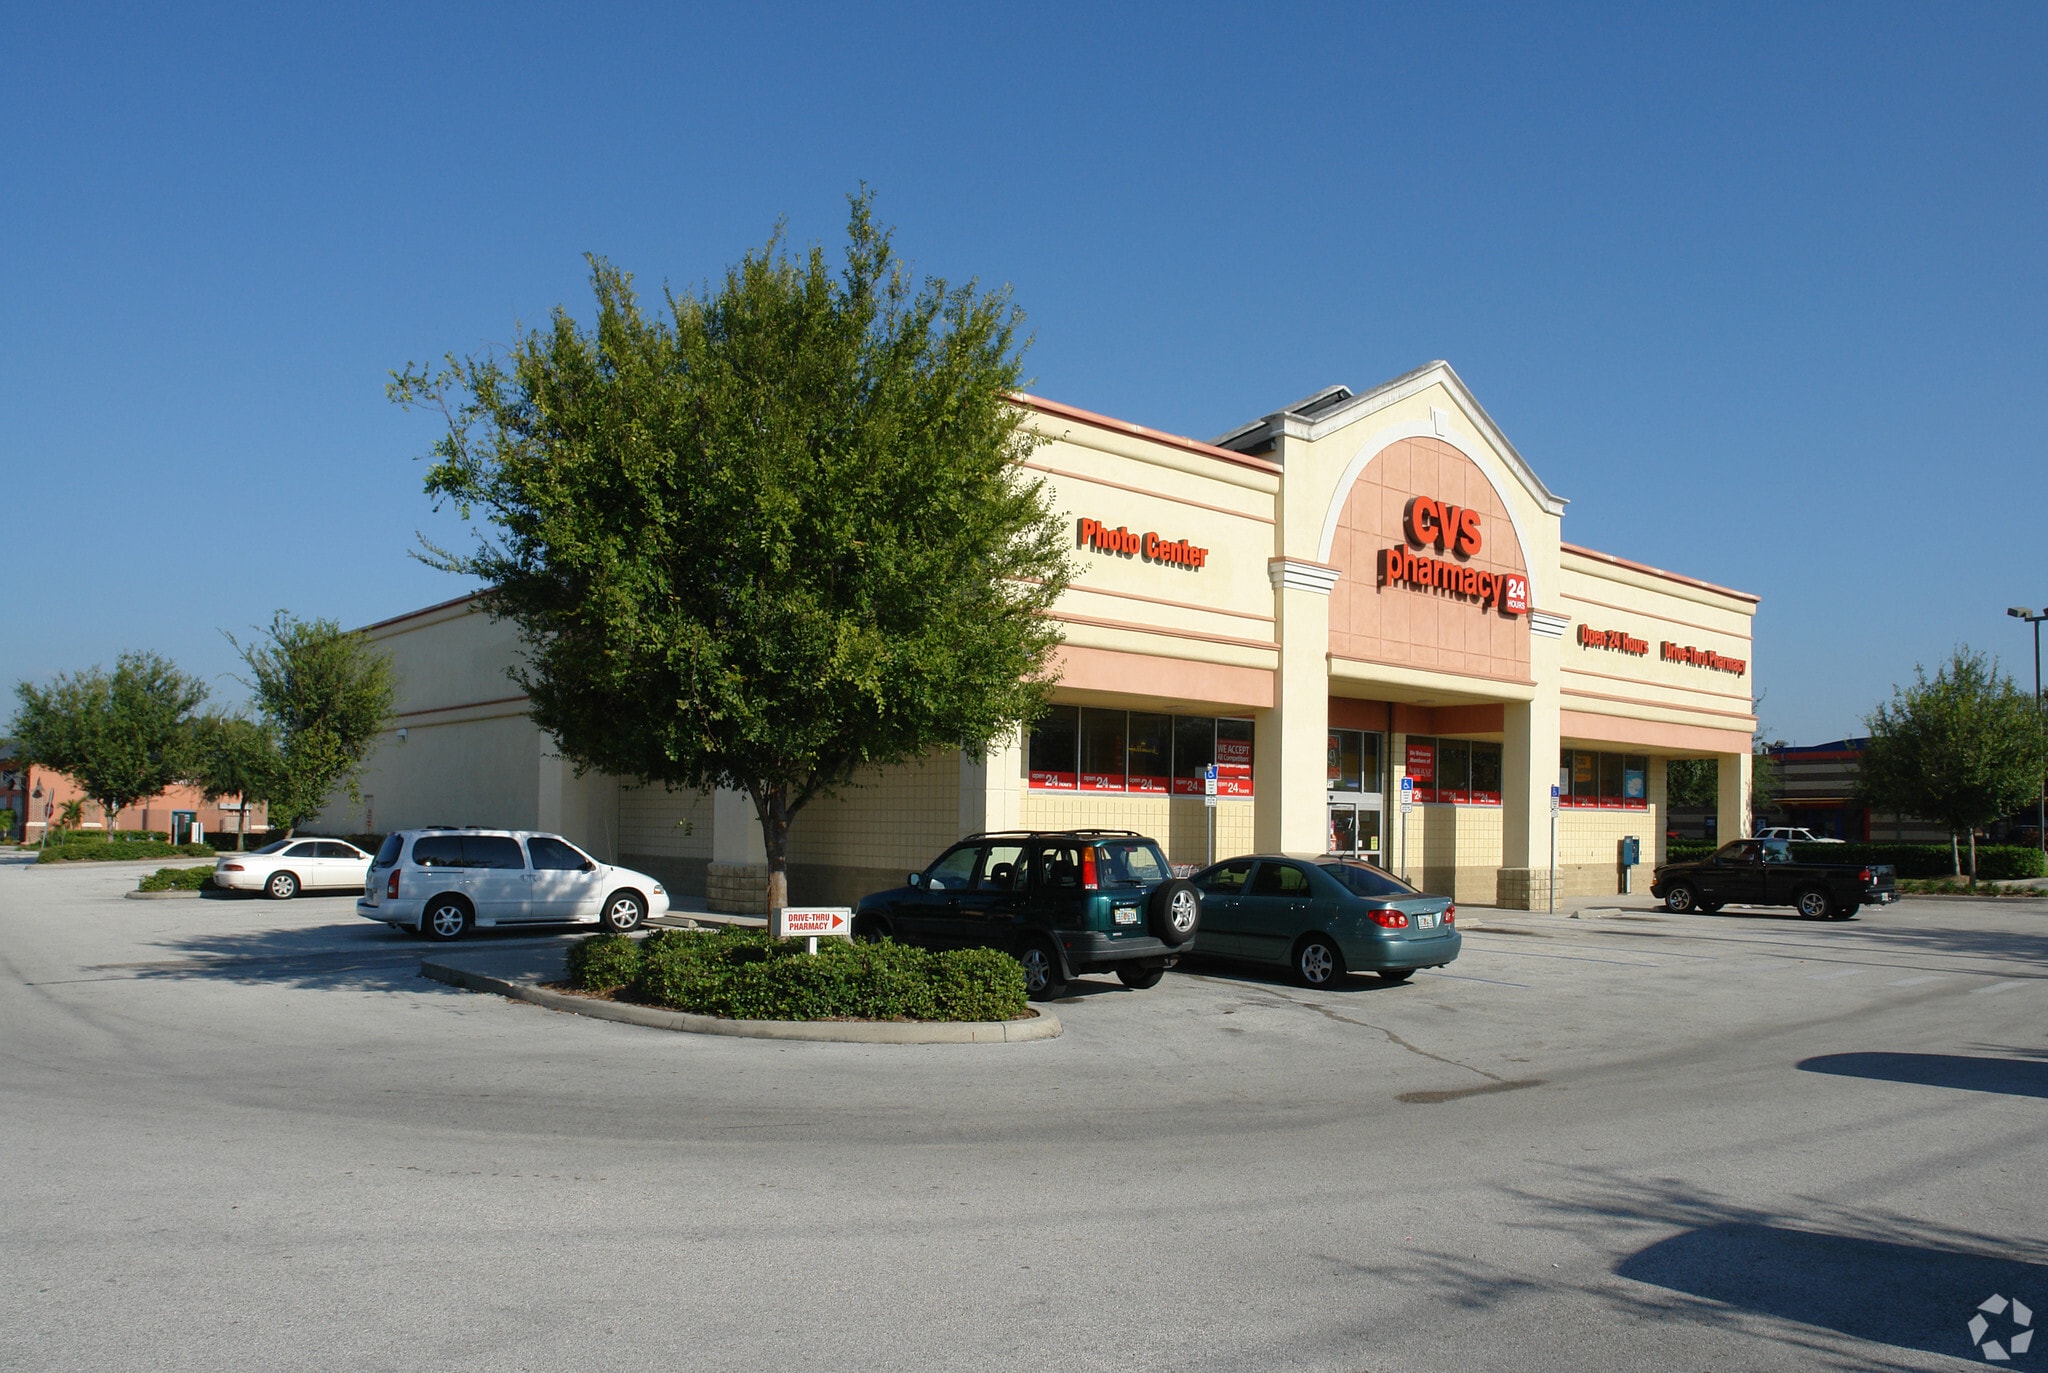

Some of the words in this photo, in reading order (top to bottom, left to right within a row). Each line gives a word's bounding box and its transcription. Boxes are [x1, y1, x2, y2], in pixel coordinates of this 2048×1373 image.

[1411, 495, 1482, 556] CVS
[1081, 517, 1141, 555] Photo
[1145, 531, 1209, 568] Center
[1385, 544, 1504, 609] pharmacy
[1508, 578, 1526, 600] 24
[1507, 599, 1526, 610] HOURS
[1581, 623, 1607, 648] Open
[1608, 629, 1621, 650] 24
[1623, 632, 1650, 655] Hours
[1664, 640, 1708, 667] Drive-Thru
[1709, 650, 1747, 676] Pharmacy
[1217, 744, 1227, 753] WE
[1228, 745, 1250, 755] ACCEPT
[1045, 774, 1059, 787] 24
[1096, 776, 1109, 789] 24
[1141, 778, 1153, 790] 24
[1187, 780, 1198, 792] 24
[1228, 782, 1239, 793] 24
[1414, 789, 1423, 801] 24
[788, 913, 830, 922] DRIVE-THRU
[789, 922, 829, 931] PHARMACY
